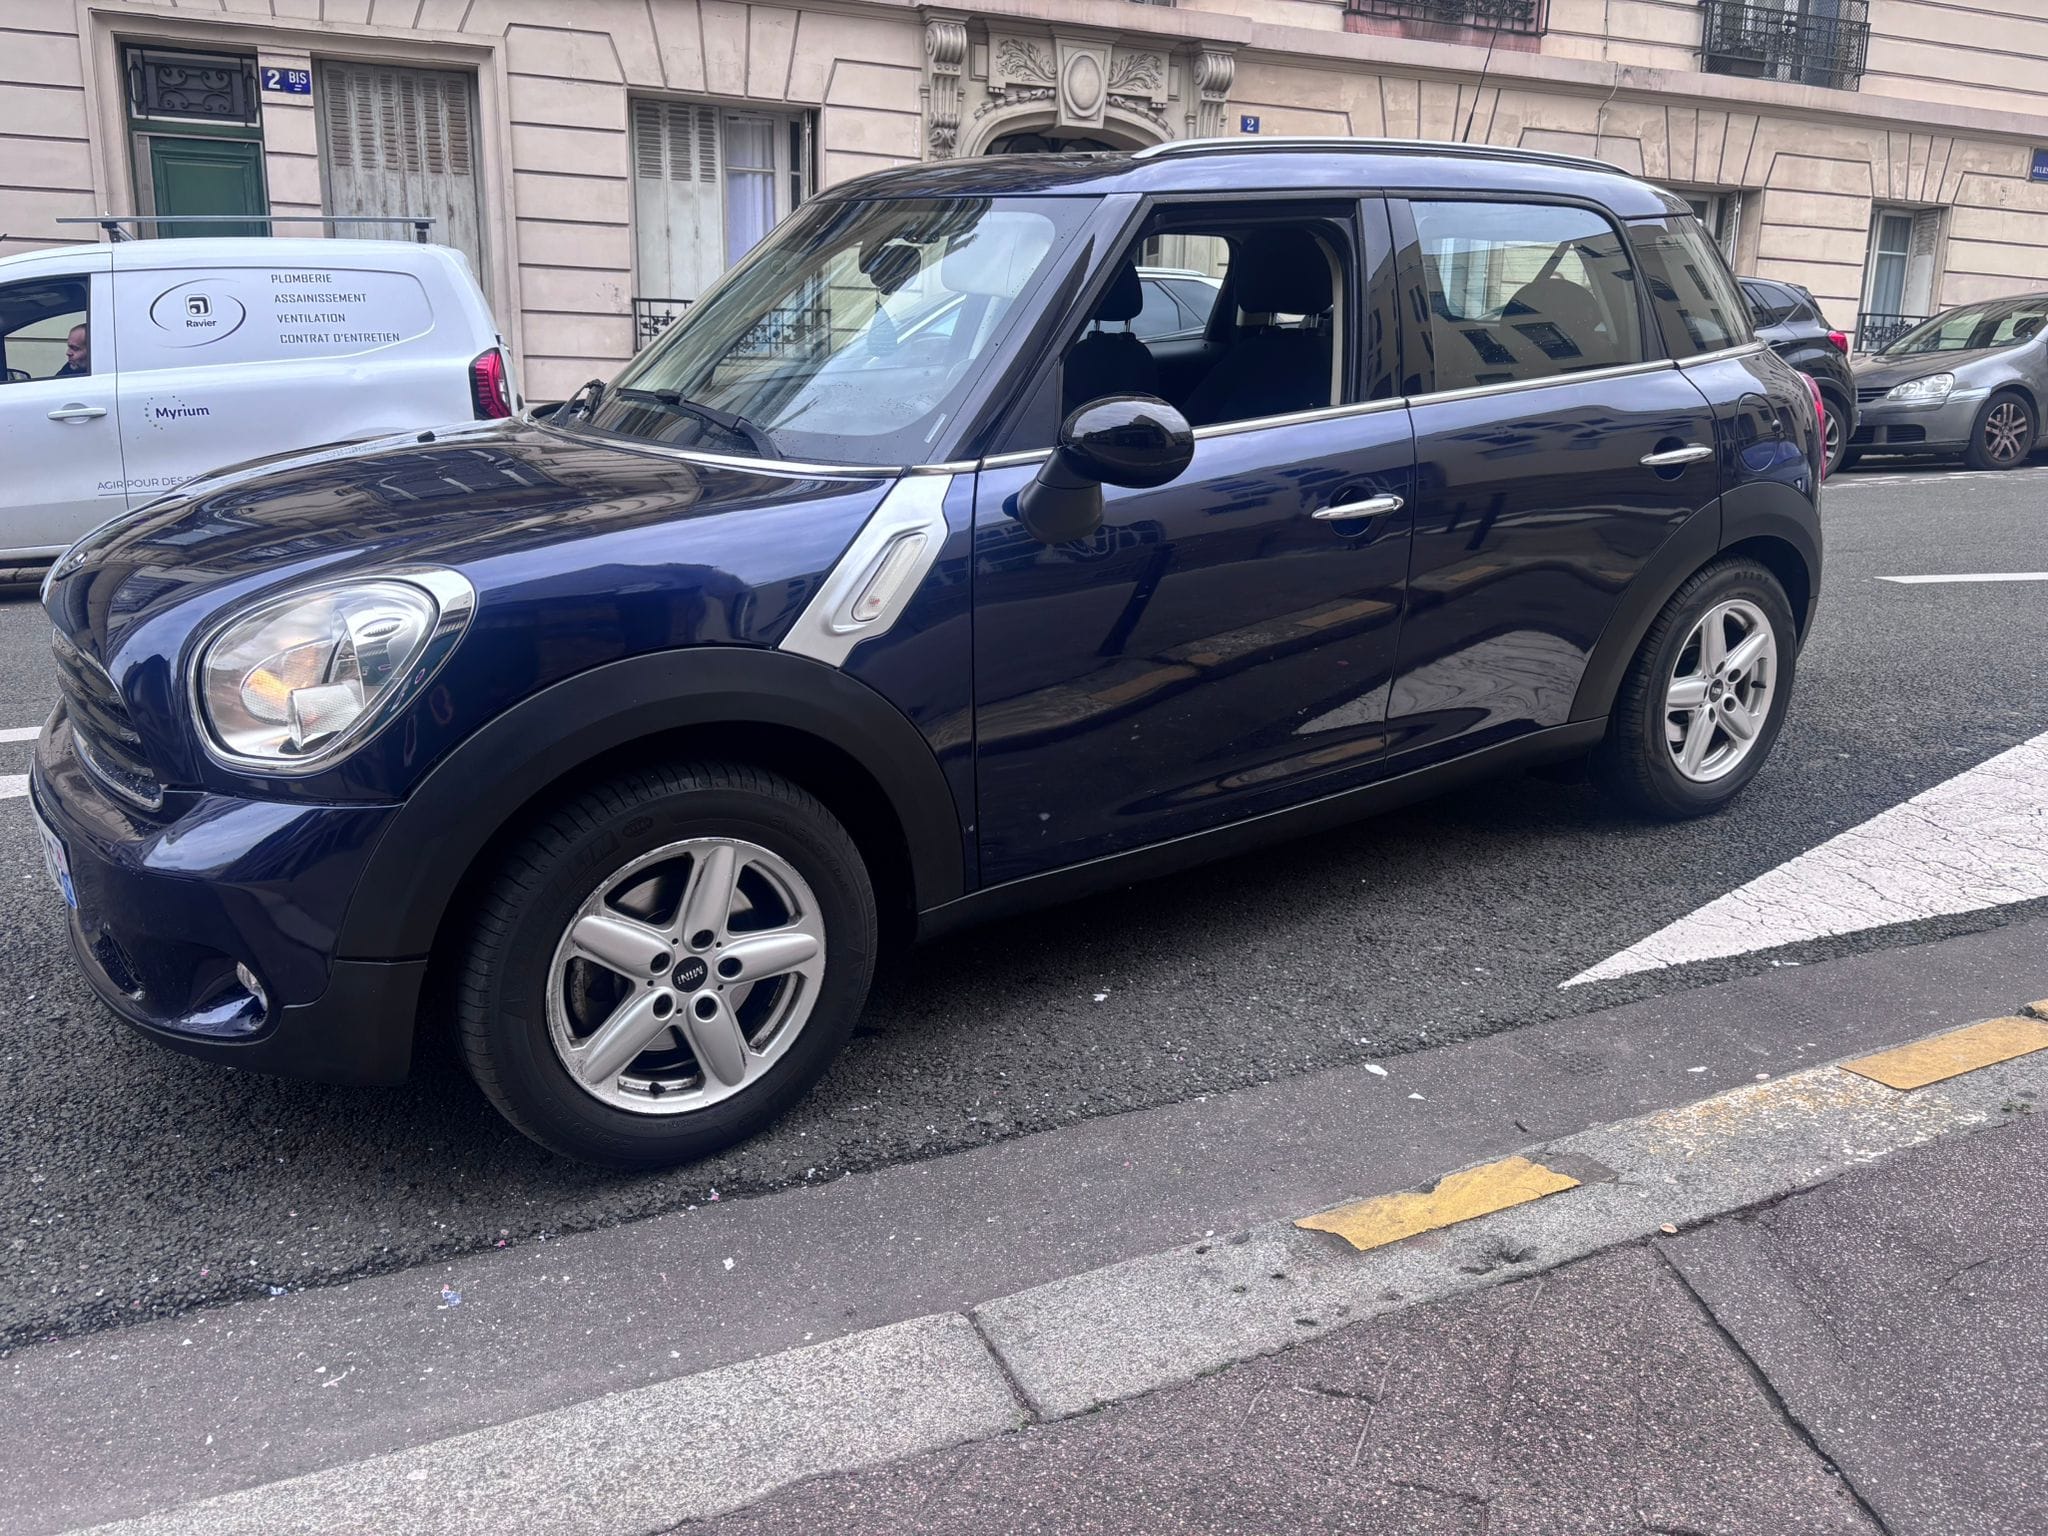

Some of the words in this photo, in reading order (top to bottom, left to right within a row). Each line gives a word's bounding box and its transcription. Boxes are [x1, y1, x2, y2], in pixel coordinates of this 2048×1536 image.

[267, 69, 281, 90] 2
[288, 71, 307, 84] BIS
[1246, 118, 1255, 131] 2
[271, 273, 333, 284] PLOMBERIE
[274, 293, 367, 303] ASSAINISSEMENT
[186, 319, 217, 328] Ravier
[277, 313, 346, 324] VENTILATION
[280, 333, 331, 344] CONTRAT
[333, 332, 401, 343] D'ENTRETIEN
[155, 407, 210, 420] Myrium
[97, 481, 124, 490] AGIR
[127, 479, 160, 488] POUR
[161, 477, 184, 486] DES
[677, 965, 703, 985] MINI
